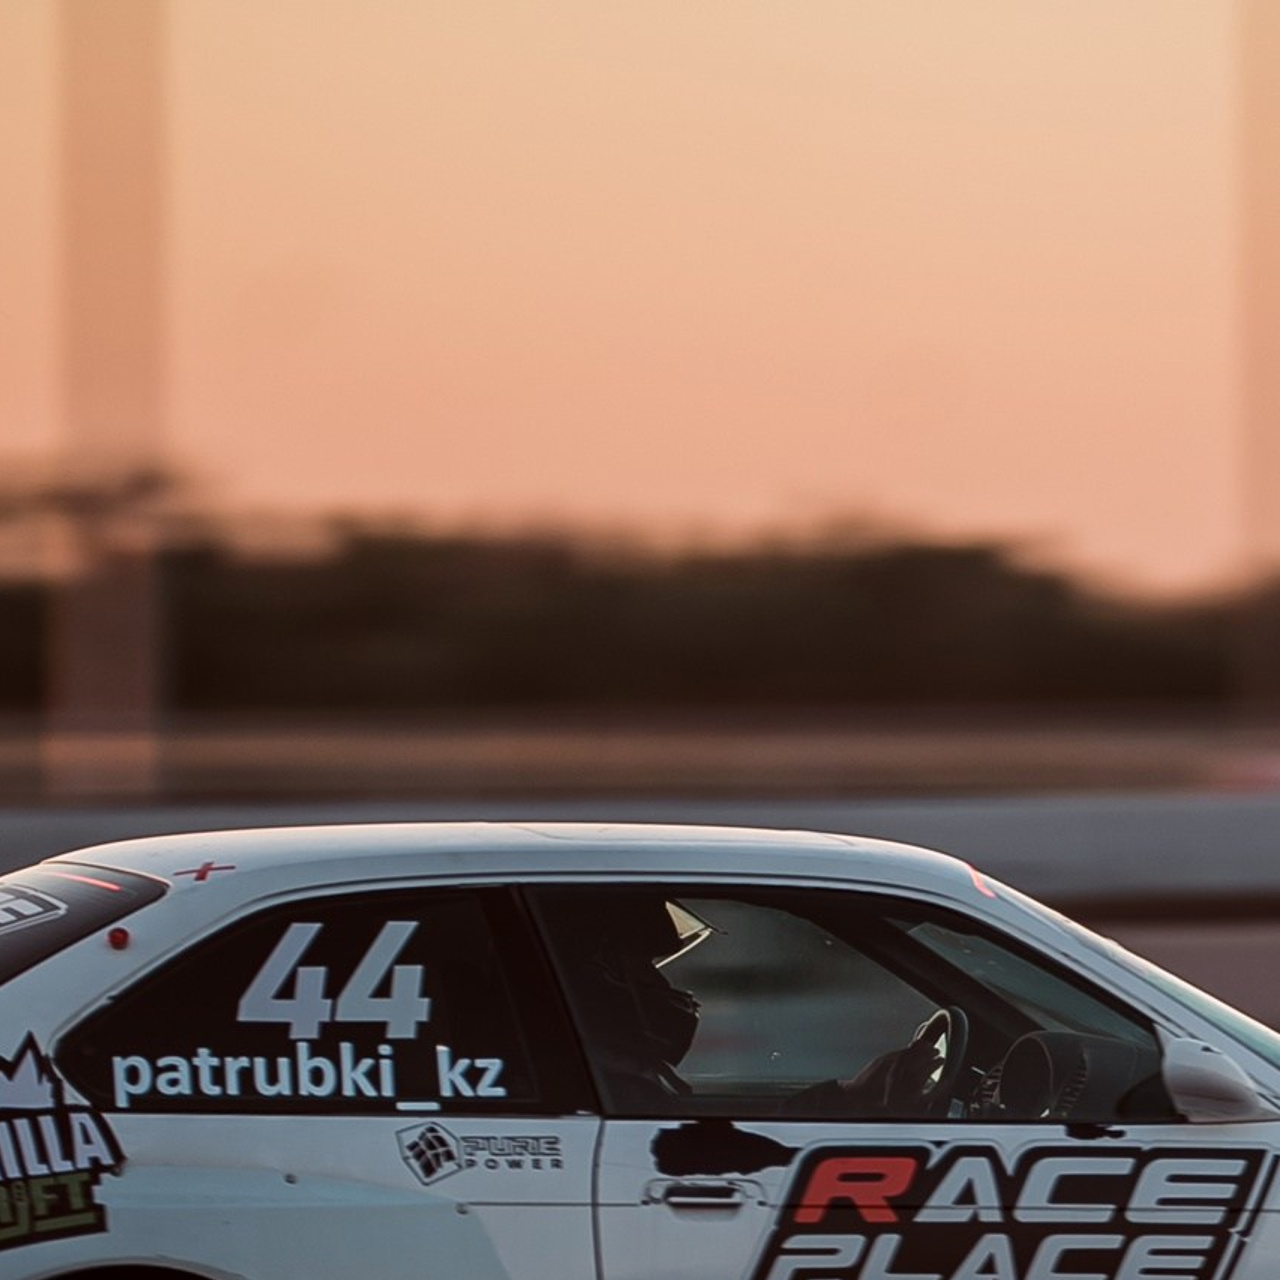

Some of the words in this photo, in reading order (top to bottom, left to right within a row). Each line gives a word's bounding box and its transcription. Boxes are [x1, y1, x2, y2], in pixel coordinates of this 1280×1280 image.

[237, 921, 430, 1039] 44
[112, 1041, 506, 1110] patrubki_kz
[0, 1112, 115, 1180] ILLA
[460, 1136, 562, 1156] PURE
[465, 1158, 563, 1170] POWER
[792, 1156, 1249, 1224] RACE
